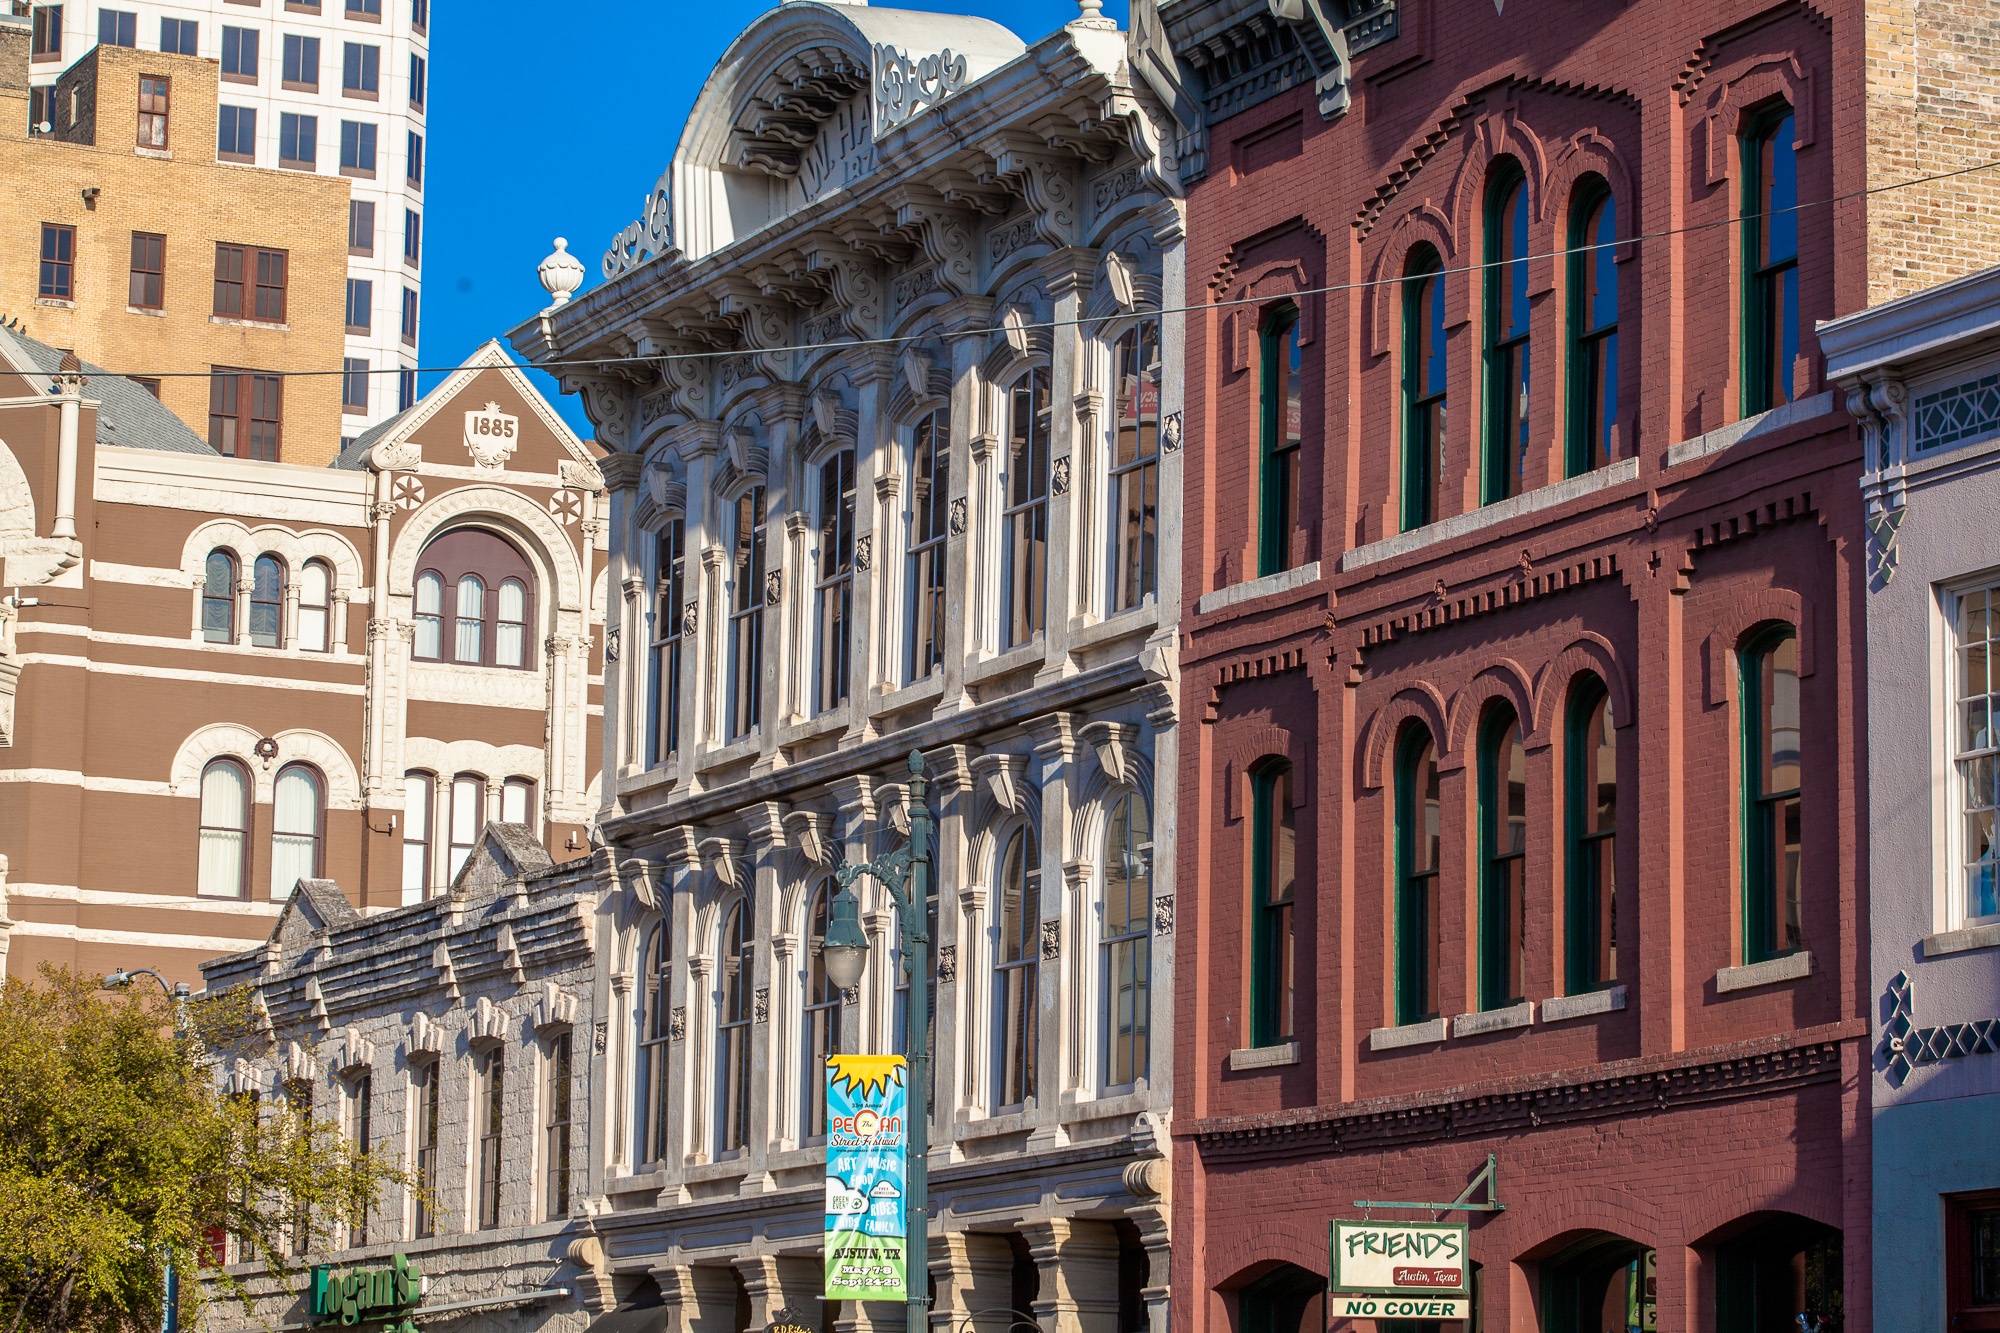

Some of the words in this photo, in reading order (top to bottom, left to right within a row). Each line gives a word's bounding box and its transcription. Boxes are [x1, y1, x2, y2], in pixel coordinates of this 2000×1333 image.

[474, 416, 514, 437] 1885
[833, 1109, 902, 1138] PECAN
[861, 1120, 873, 1128] The
[831, 1134, 861, 1147] Street
[861, 1133, 901, 1147] Festival
[838, 1157, 857, 1173] ART
[868, 1156, 897, 1172] MUSIC
[851, 1173, 873, 1186] FOOD
[832, 1202, 850, 1210] EVENT
[871, 1201, 898, 1216] RIDES
[839, 1217, 859, 1228] KIDS
[865, 1220, 895, 1233] FAMILY
[1345, 1230, 1461, 1260] FRIENDS
[832, 1248, 882, 1261] AUSTIN,
[884, 1248, 901, 1260] TX
[842, 1265, 870, 1275] May
[872, 1266, 893, 1275] 7-8
[1397, 1269, 1430, 1284] Austin,
[1433, 1269, 1458, 1283] Texas
[832, 1277, 863, 1287] Sept
[865, 1278, 901, 1287] 24-25
[309, 1254, 420, 1327] Logan's
[1345, 1301, 1377, 1316] NO
[1384, 1301, 1456, 1317] COVER
